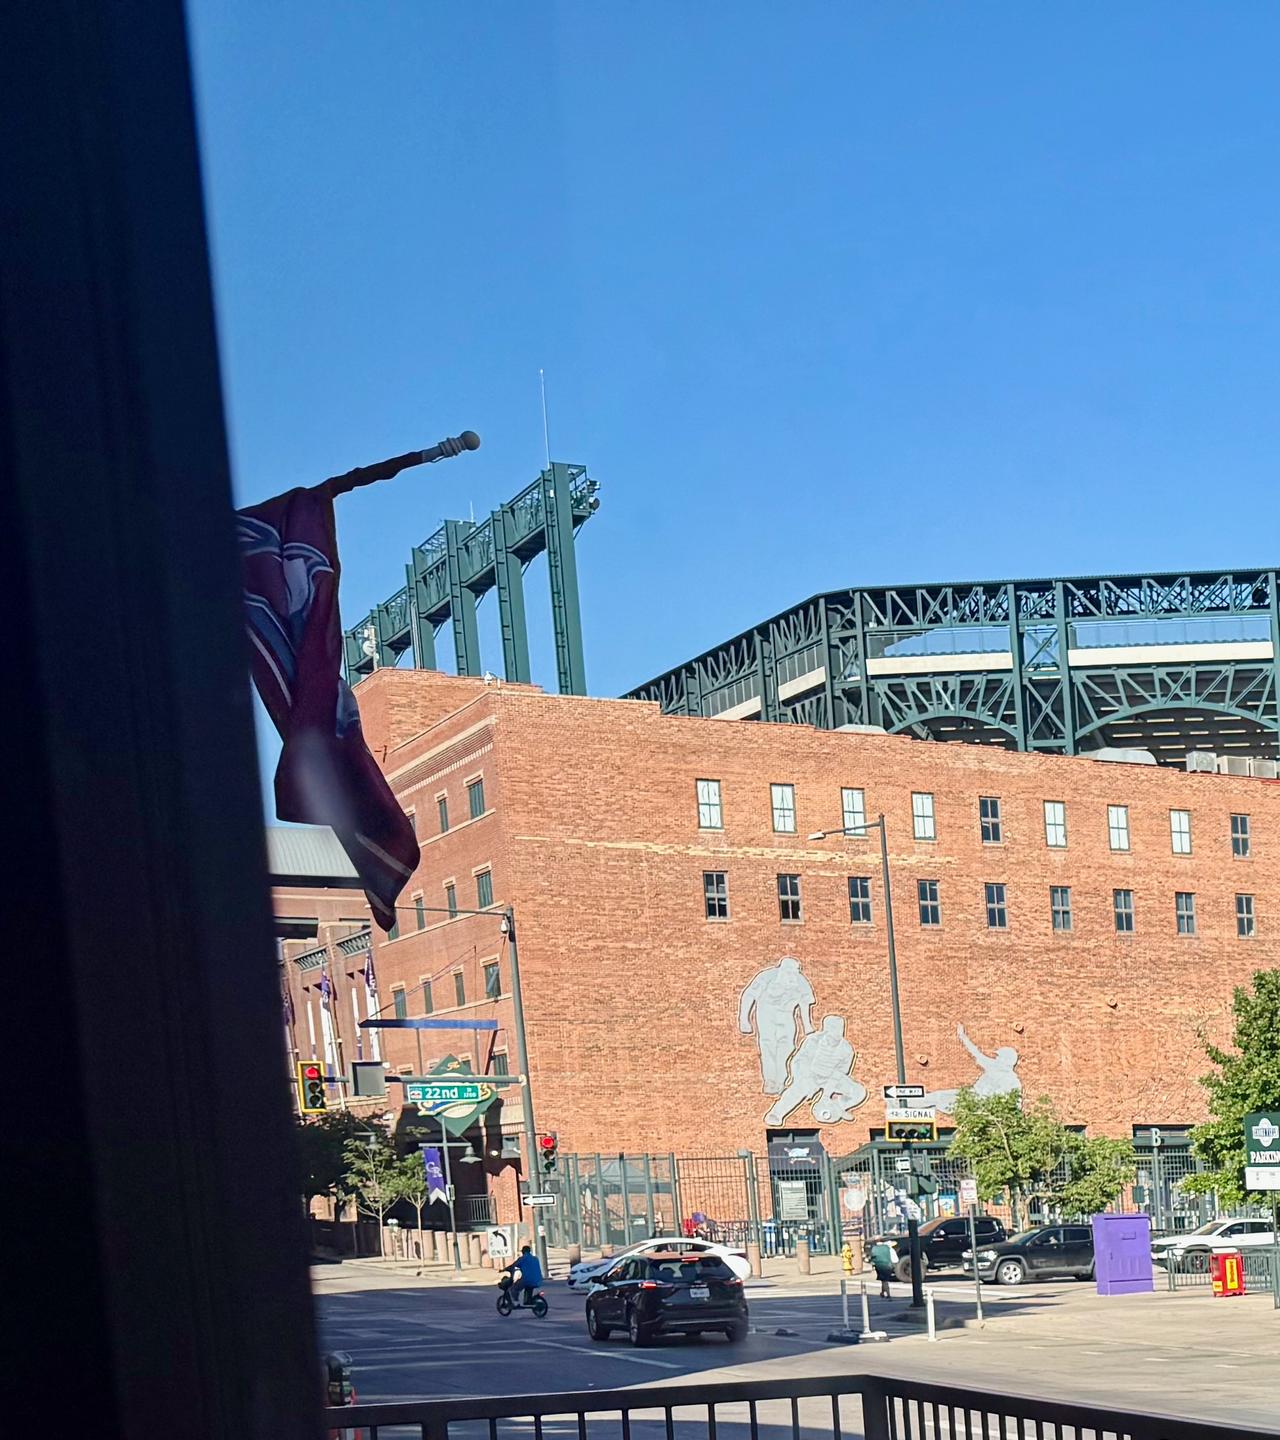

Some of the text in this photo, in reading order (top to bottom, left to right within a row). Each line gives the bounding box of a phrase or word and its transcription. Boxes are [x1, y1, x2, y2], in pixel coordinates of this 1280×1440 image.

[425, 1087, 459, 1099] 22nd
[904, 1110, 933, 1119] SIGNAL
[1150, 1127, 1162, 1147] B
